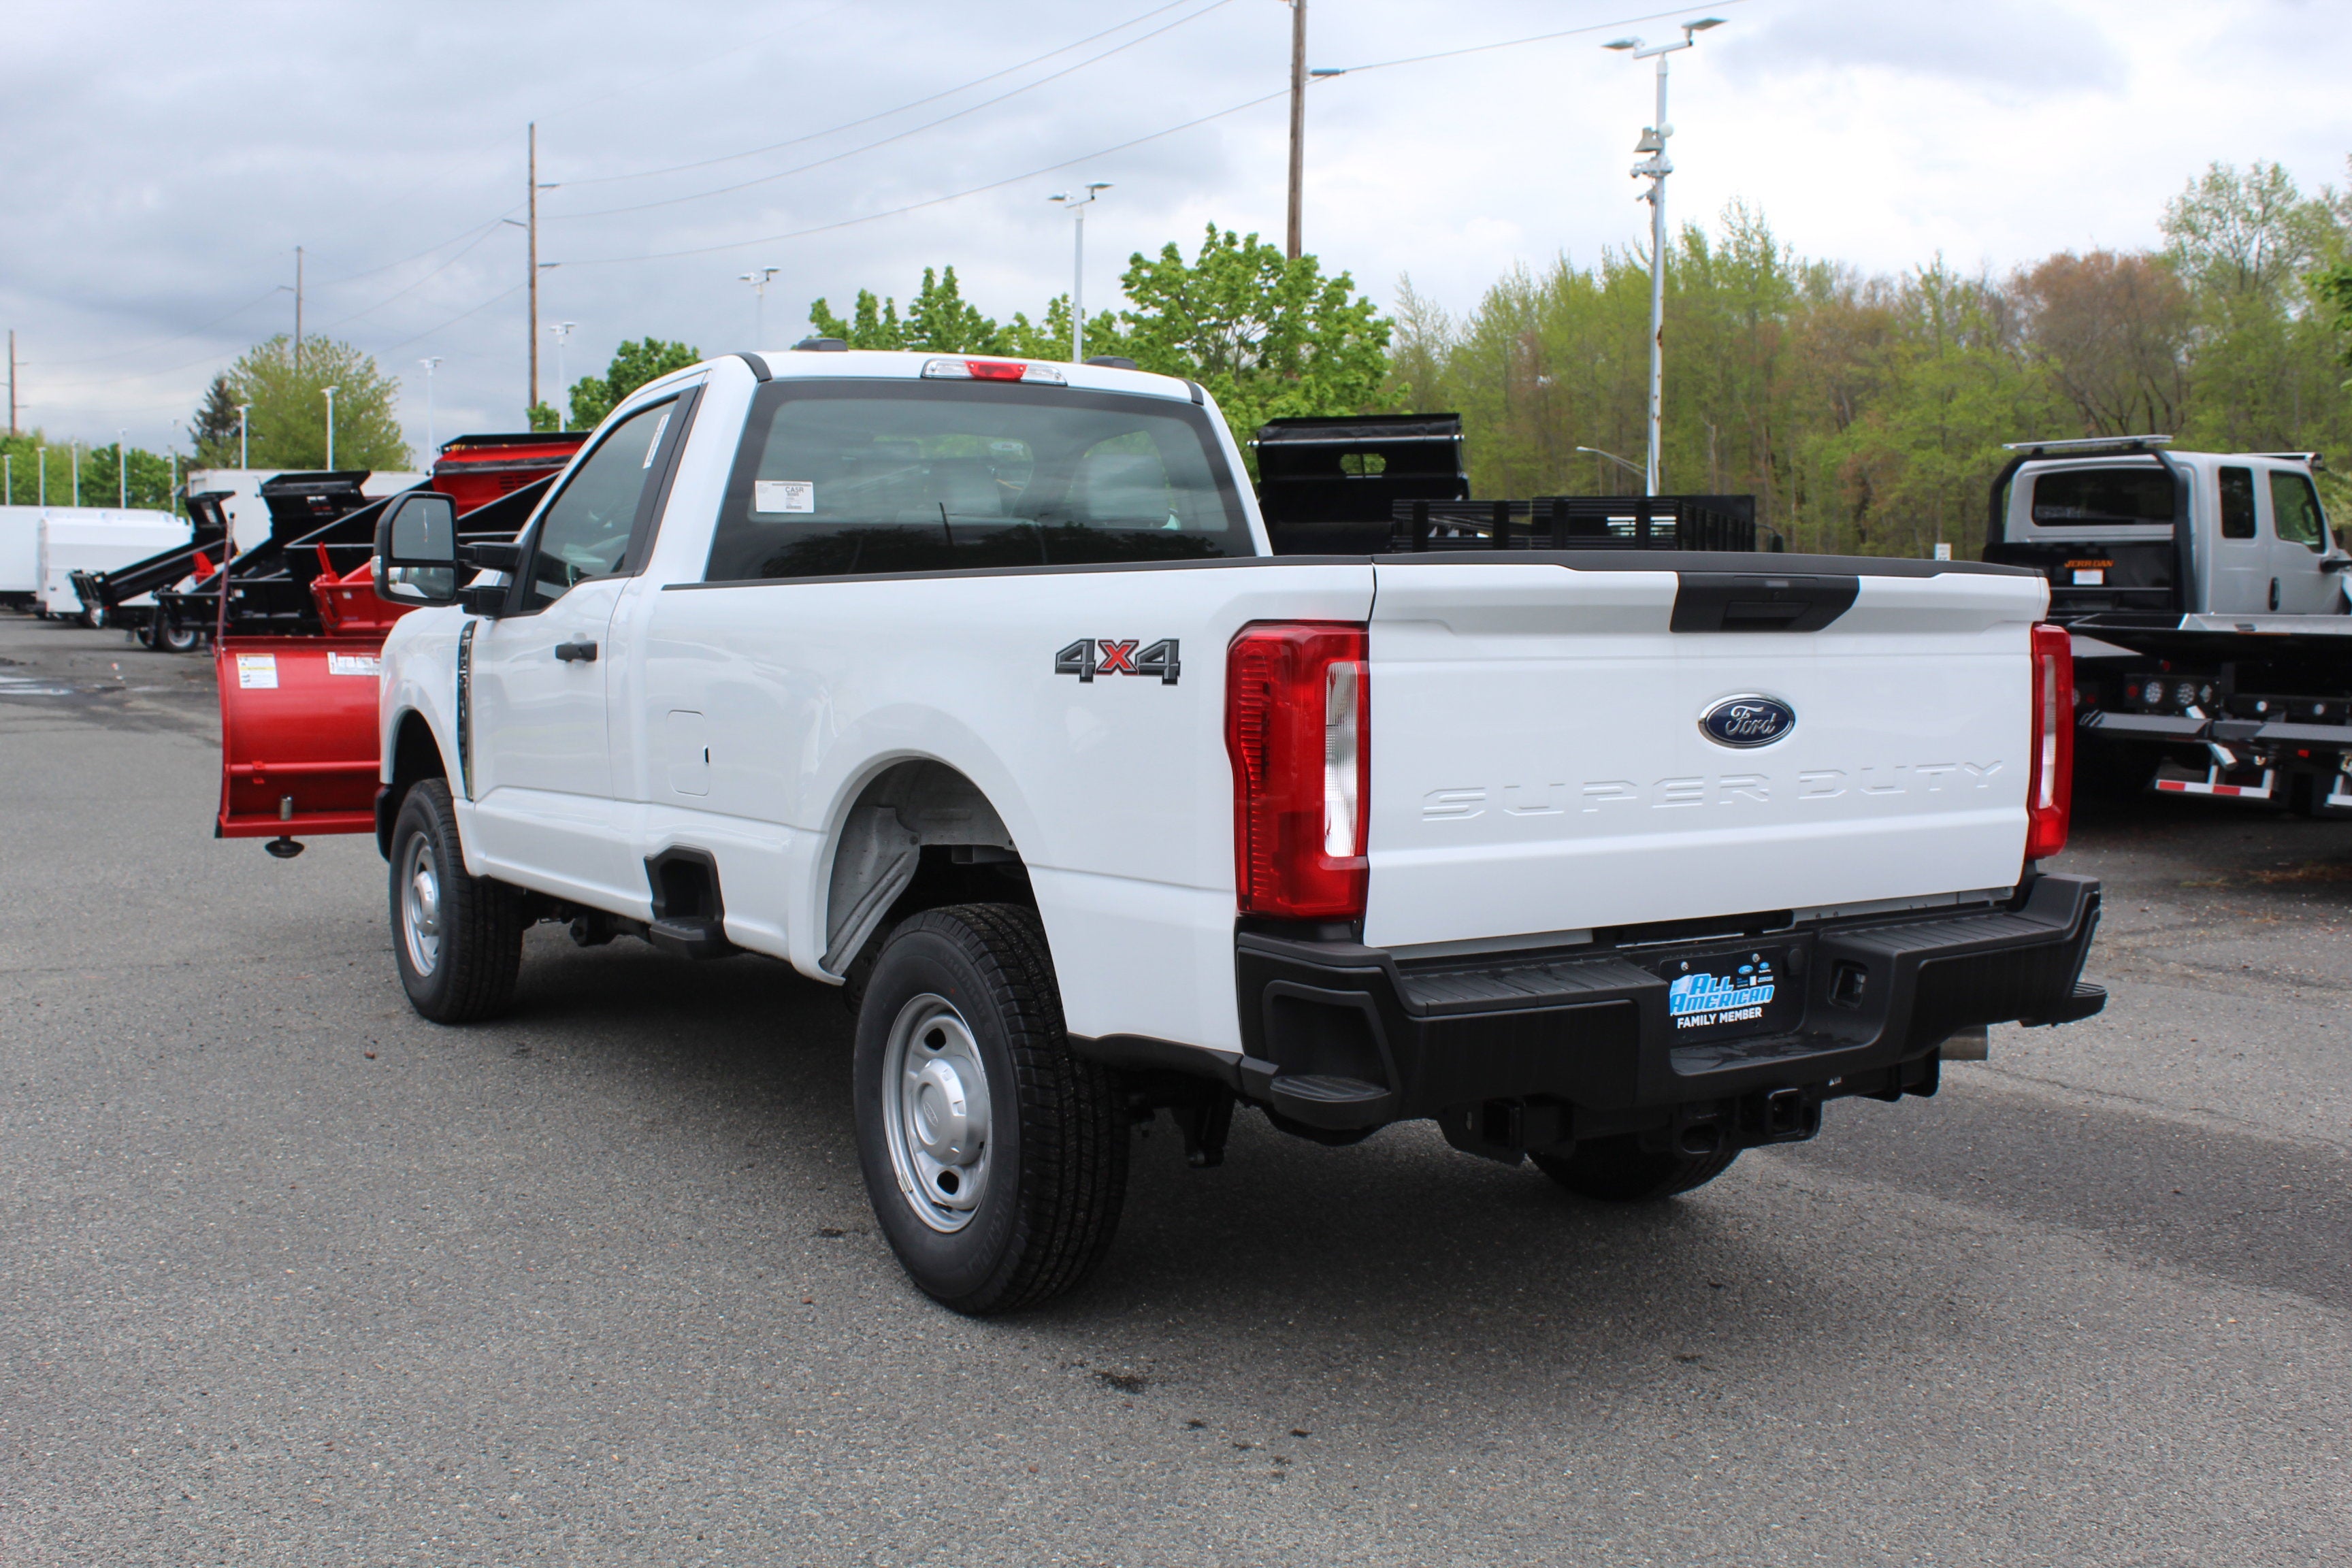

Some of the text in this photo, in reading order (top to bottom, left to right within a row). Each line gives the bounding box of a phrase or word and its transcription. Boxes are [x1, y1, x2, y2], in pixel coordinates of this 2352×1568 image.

[1725, 705, 1777, 736] Ford
[1422, 760, 2003, 821] SUPER DUTY
[1677, 1007, 1763, 1029] FAMILY MEMBER
